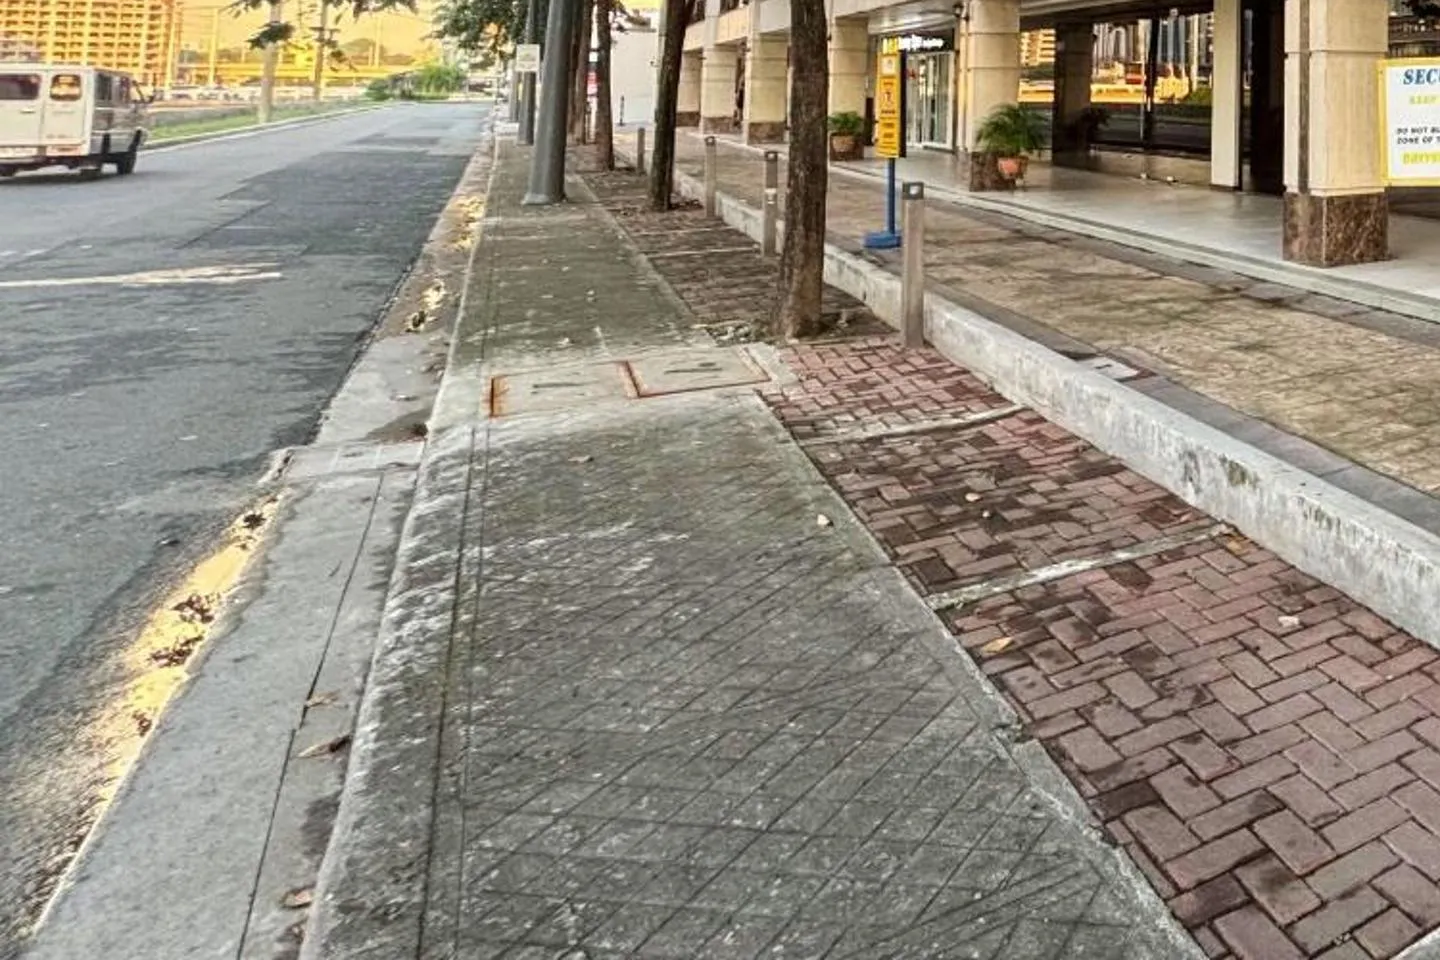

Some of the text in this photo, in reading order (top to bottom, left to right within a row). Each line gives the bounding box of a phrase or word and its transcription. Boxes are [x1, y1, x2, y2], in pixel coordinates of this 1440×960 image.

[1397, 127, 1408, 135] DO
[1411, 126, 1428, 134] NOT
[1397, 136, 1419, 144] ZONE
[1422, 135, 1433, 144] OF
